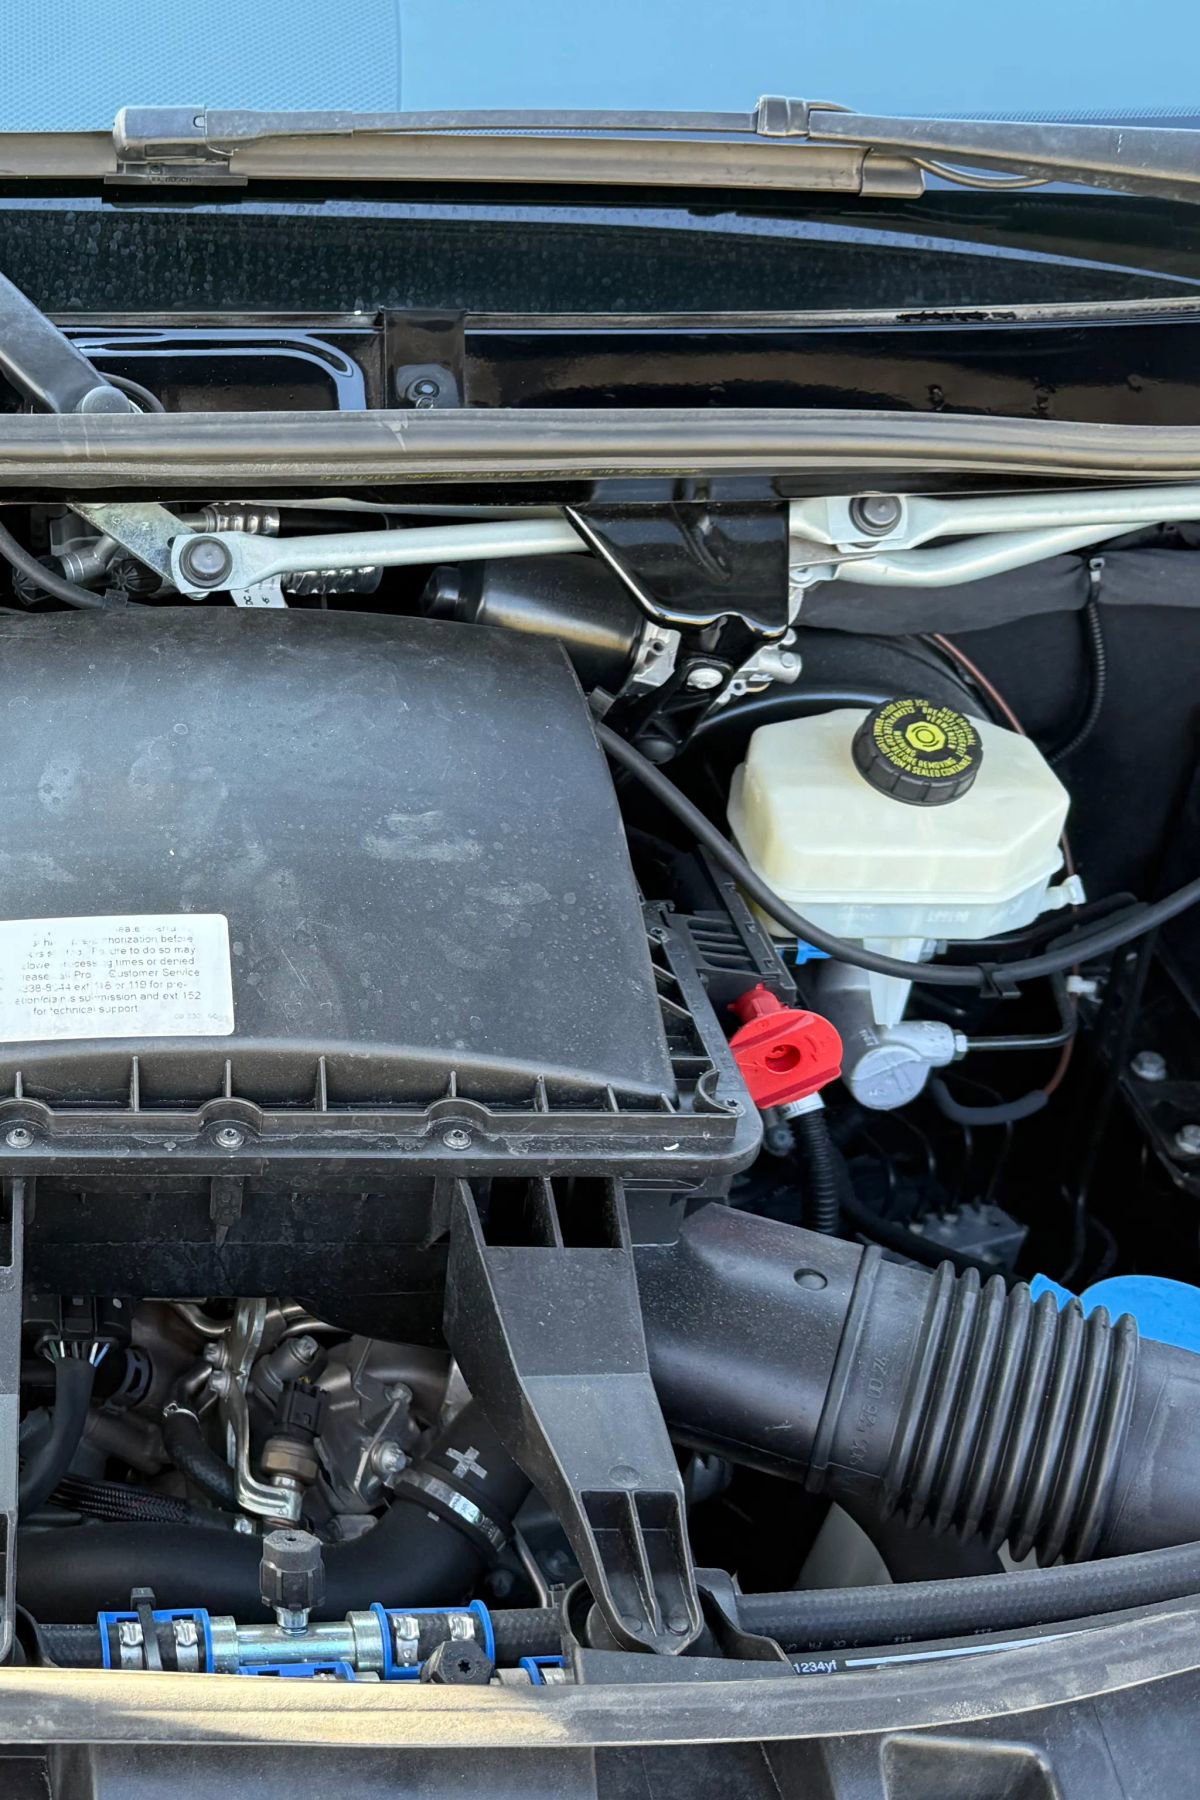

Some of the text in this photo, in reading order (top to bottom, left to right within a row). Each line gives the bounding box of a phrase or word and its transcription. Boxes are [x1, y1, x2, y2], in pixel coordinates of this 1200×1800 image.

[893, 731, 917, 757] WARNING
[883, 735, 897, 747] CAP
[890, 746, 918, 766] BEFORE
[918, 757, 957, 769] REMOVING
[885, 750, 907, 769] FROM
[911, 766, 941, 778] SEALED
[129, 946, 141, 955] to
[142, 945, 156, 955] do
[159, 946, 171, 954] so
[161, 967, 201, 977] Service
[129, 980, 147, 989] 119
[149, 979, 163, 989] for
[140, 991, 160, 1001] and
[162, 992, 179, 1001] ext
[182, 990, 202, 1000] 152
[33, 1006, 46, 1016] for
